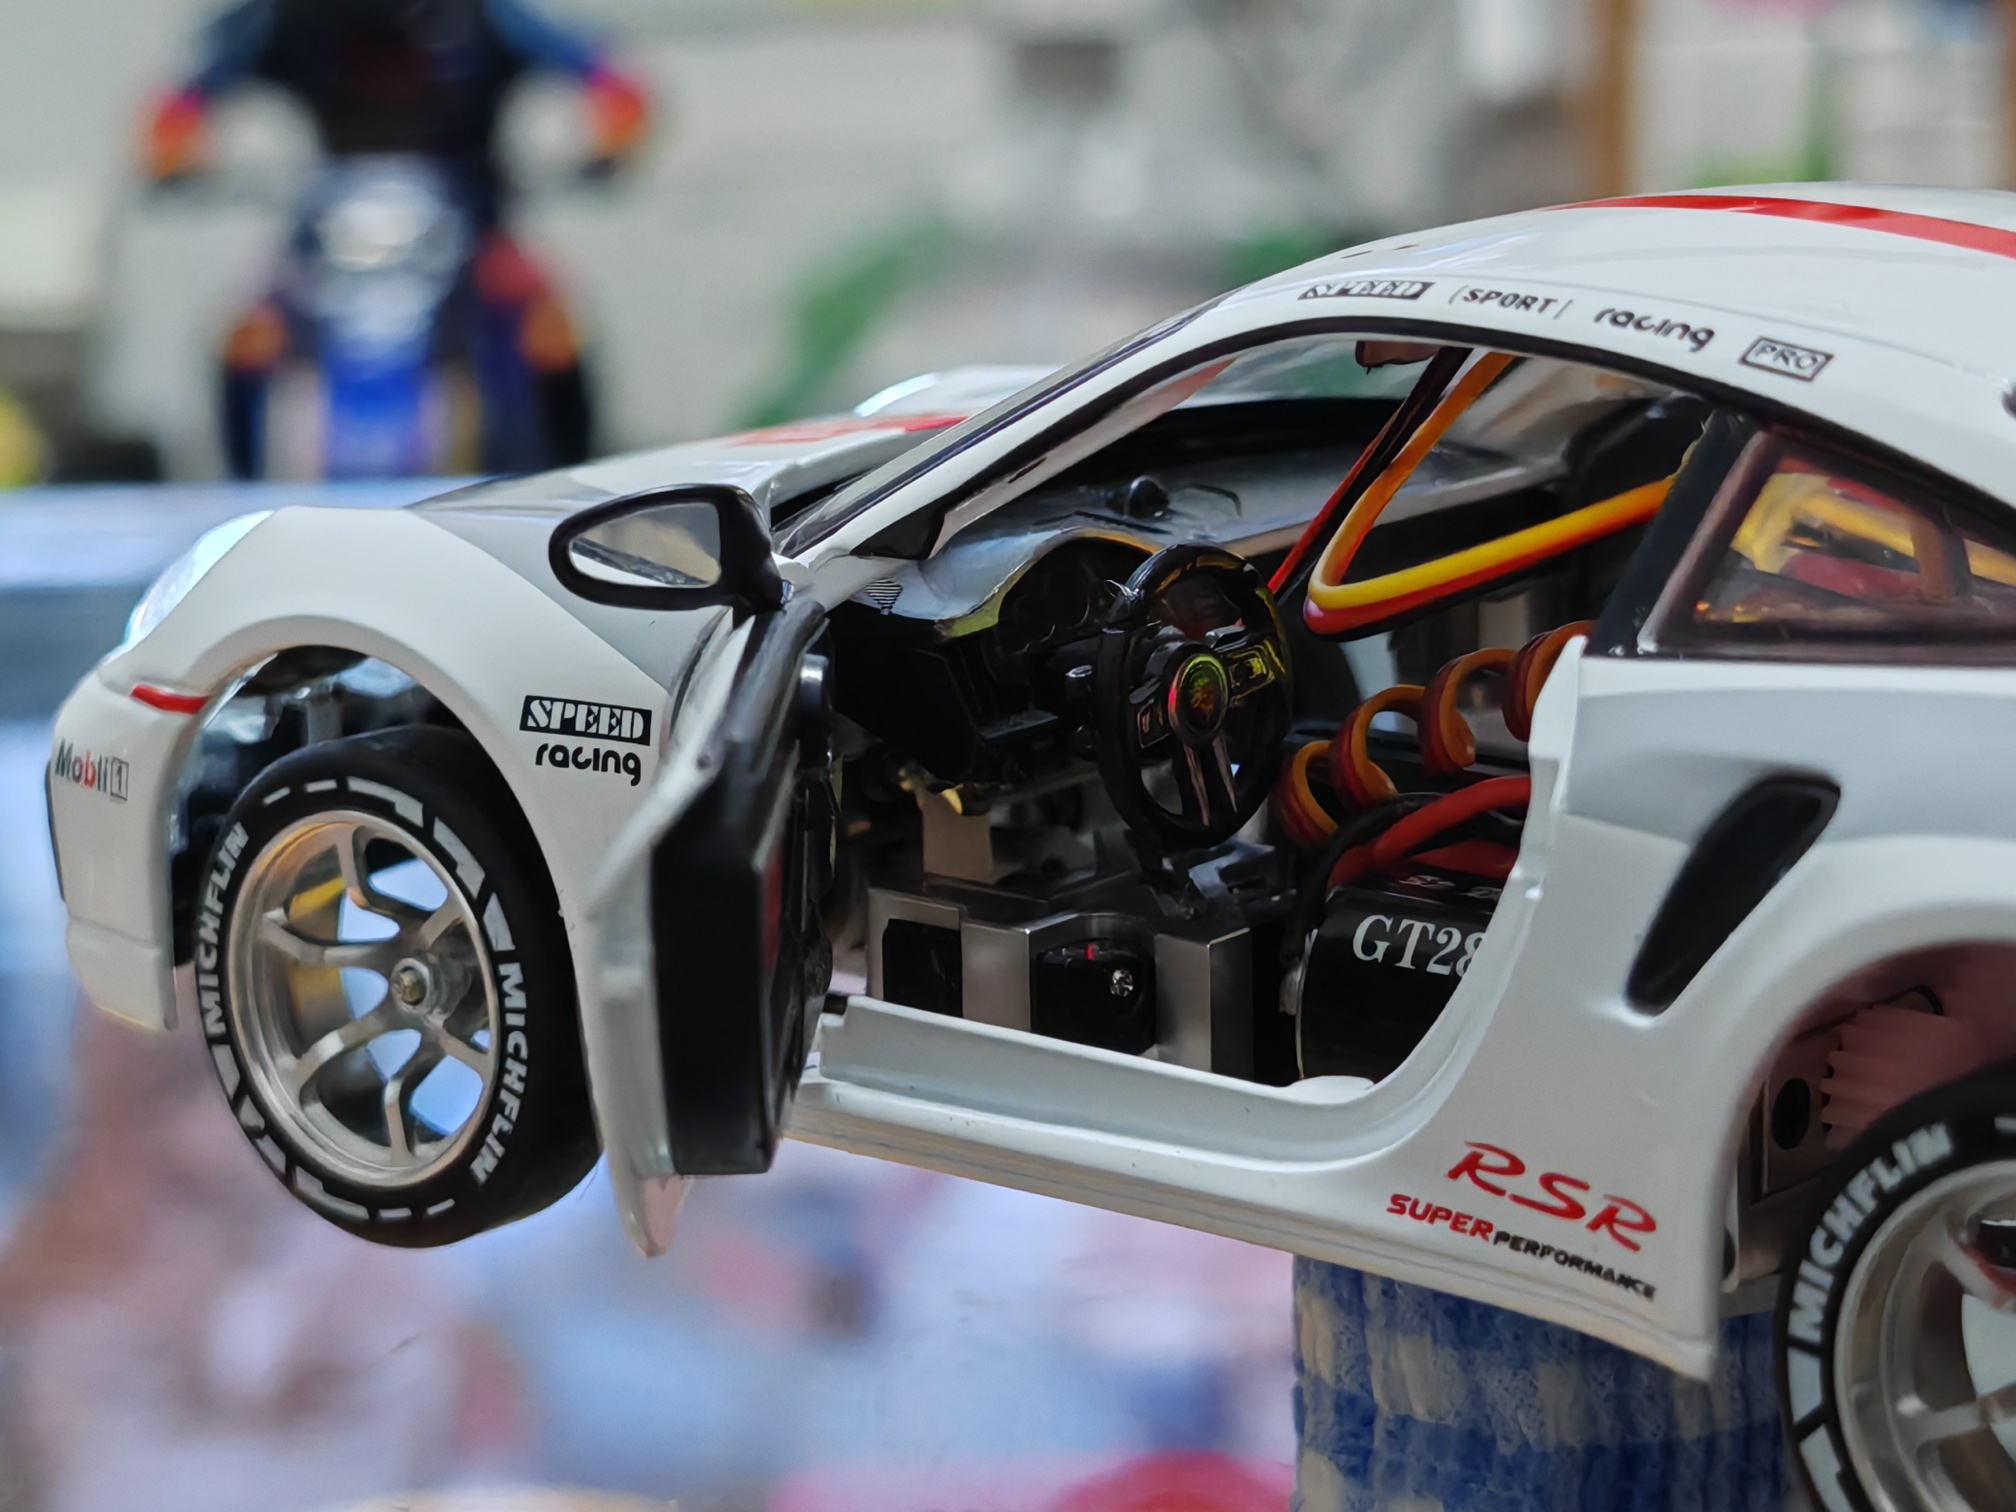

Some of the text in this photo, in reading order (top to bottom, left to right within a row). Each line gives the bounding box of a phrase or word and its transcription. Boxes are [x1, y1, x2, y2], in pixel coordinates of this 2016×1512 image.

[1593, 307, 1716, 353] racing
[524, 698, 647, 741] SPEED
[535, 743, 642, 787] racing
[1445, 1141, 1657, 1252] RSR
